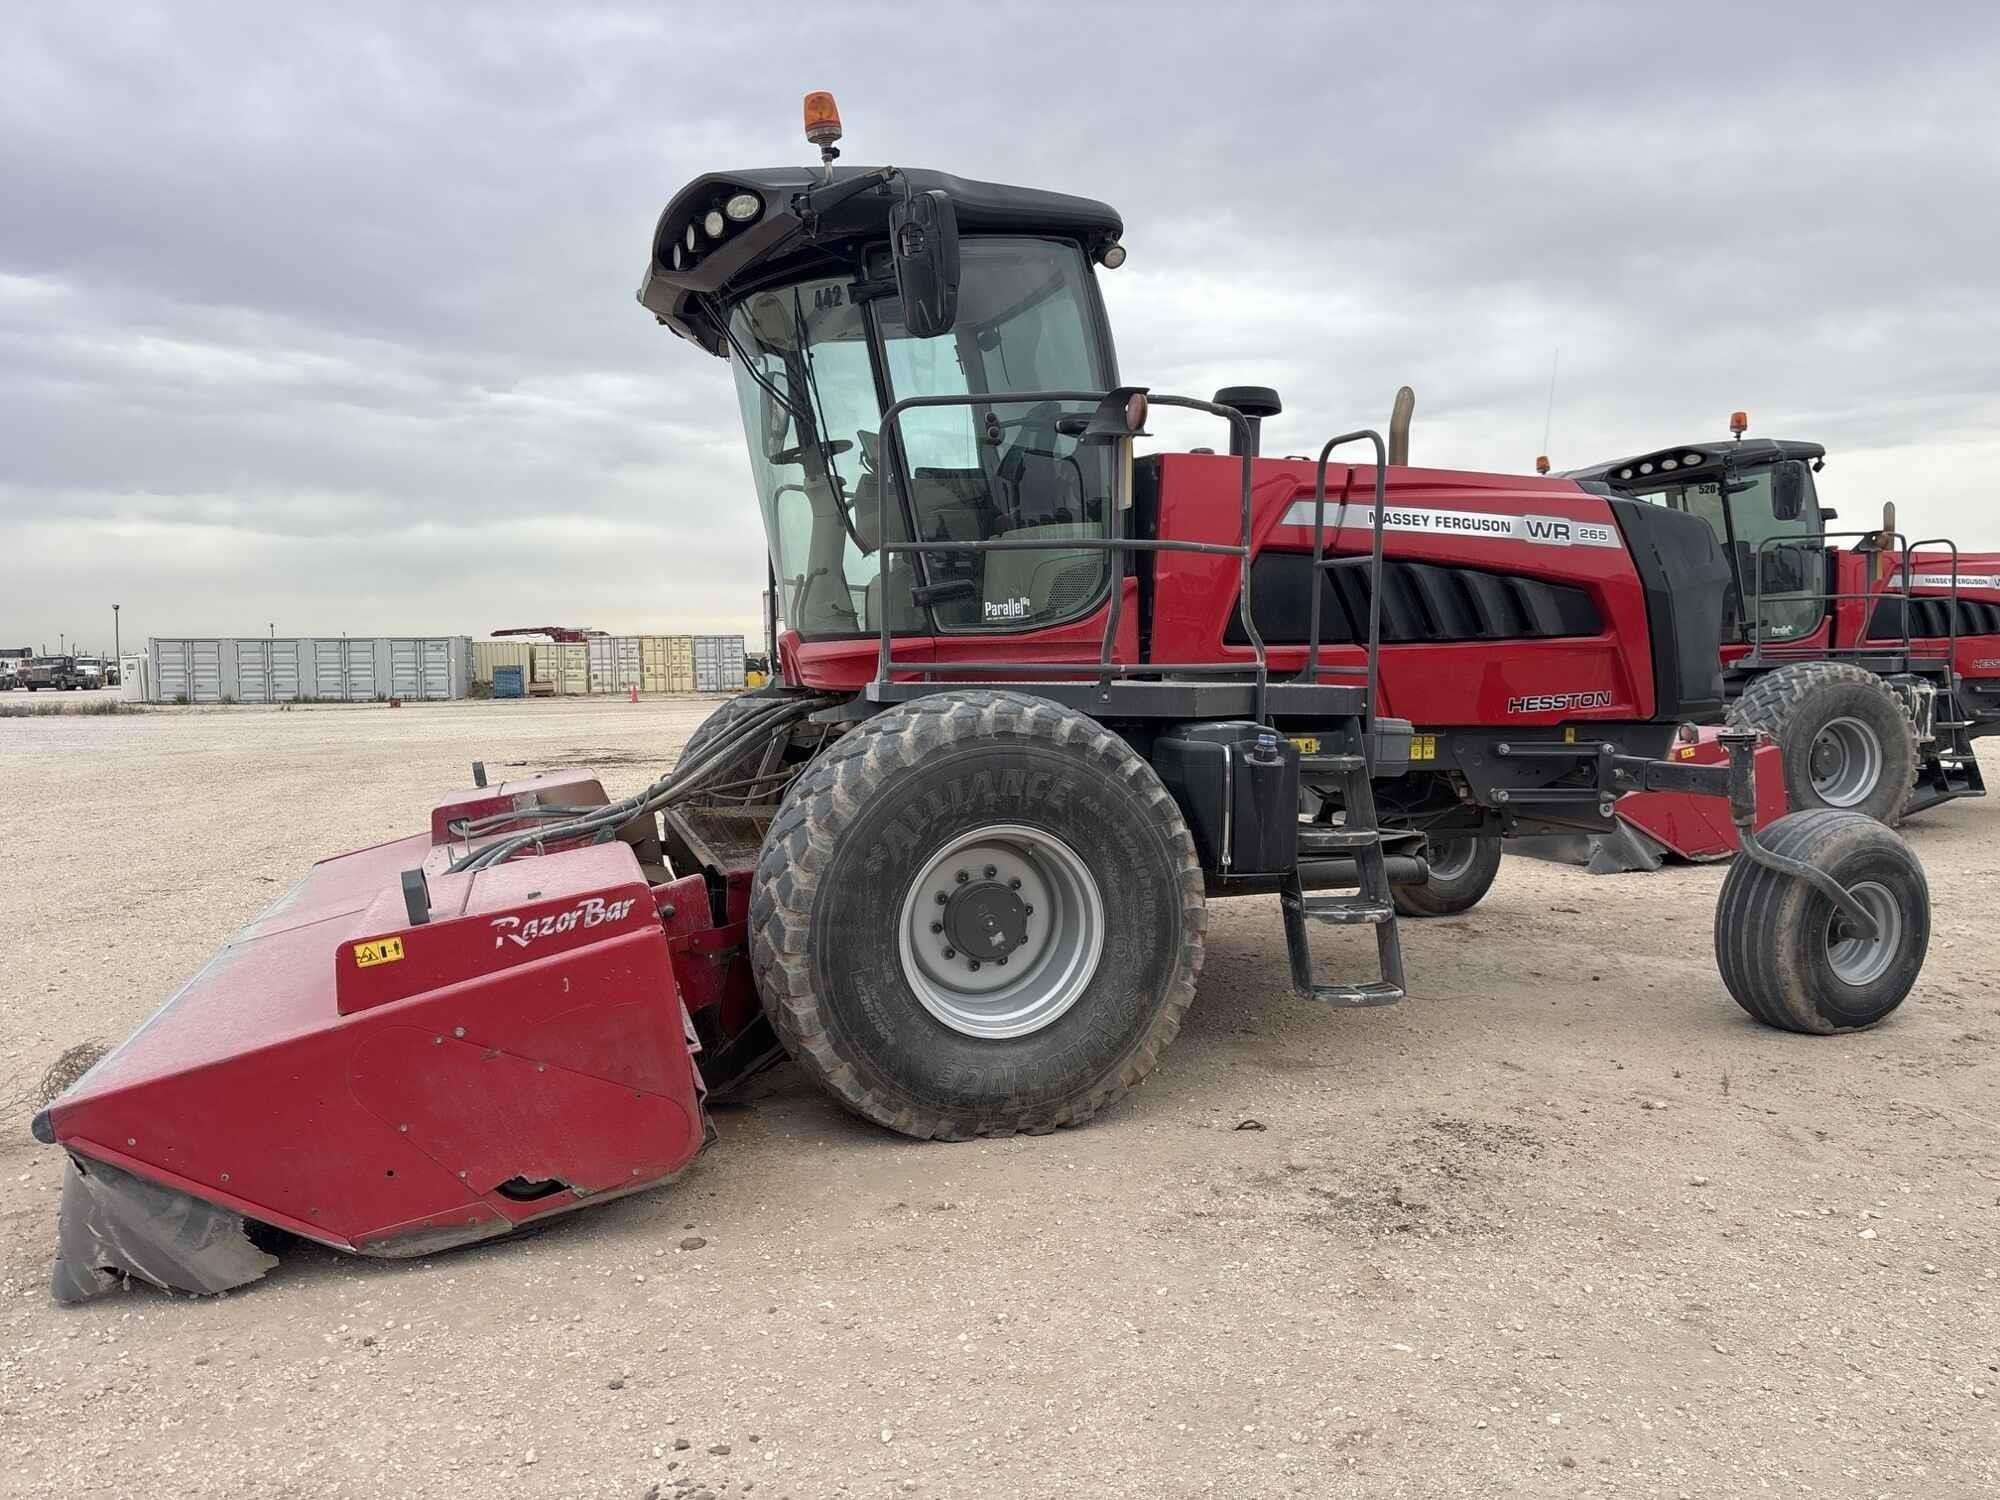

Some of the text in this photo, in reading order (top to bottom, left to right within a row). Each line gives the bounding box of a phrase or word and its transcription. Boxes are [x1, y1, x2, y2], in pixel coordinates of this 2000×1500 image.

[815, 285, 842, 308] 442
[1435, 515, 1511, 533] FERGUSON
[1526, 520, 1570, 541] WR
[1579, 528, 1608, 541] 265
[984, 597, 1025, 617] Parallel
[1507, 690, 1612, 713] HESSTON
[879, 768, 1077, 866] ALLIANCE
